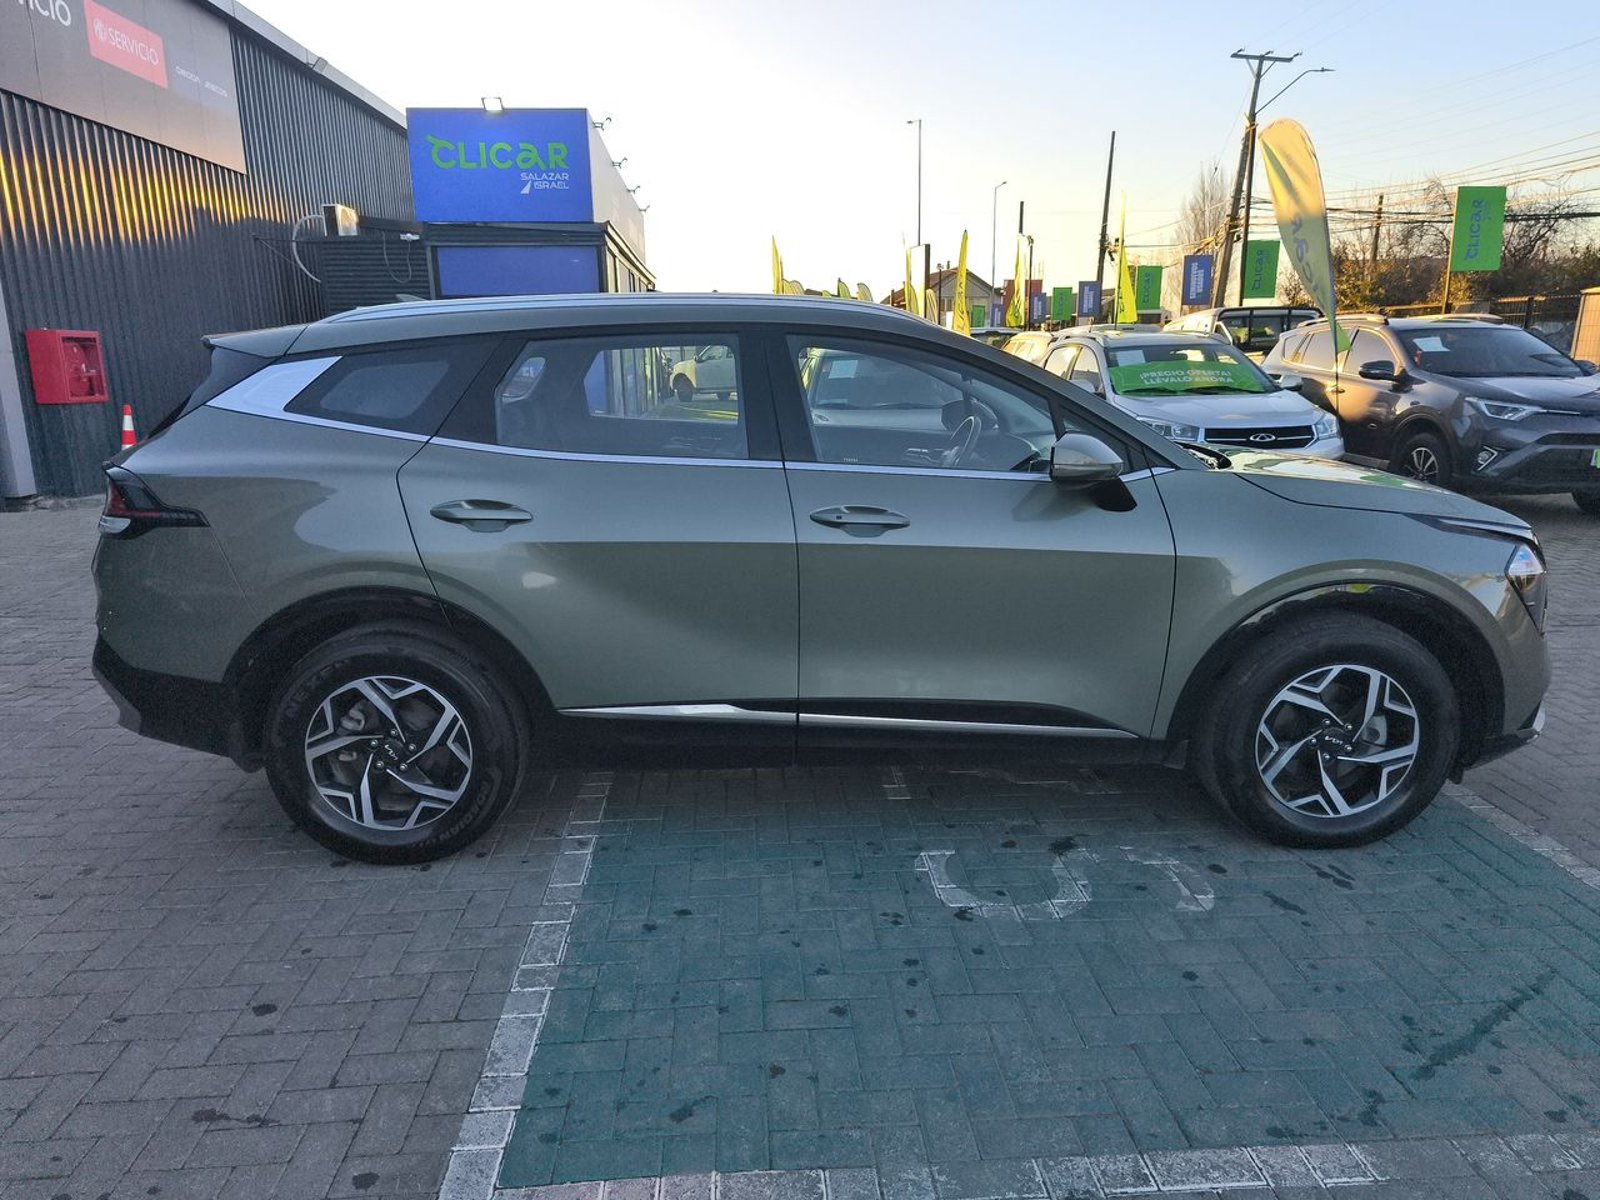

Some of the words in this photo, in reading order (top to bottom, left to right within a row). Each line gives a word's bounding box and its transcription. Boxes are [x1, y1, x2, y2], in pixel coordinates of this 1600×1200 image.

[107, 27, 160, 65] SERVICIO
[520, 172, 569, 181] SALAZAR
[534, 180, 569, 190] ISRAEL
